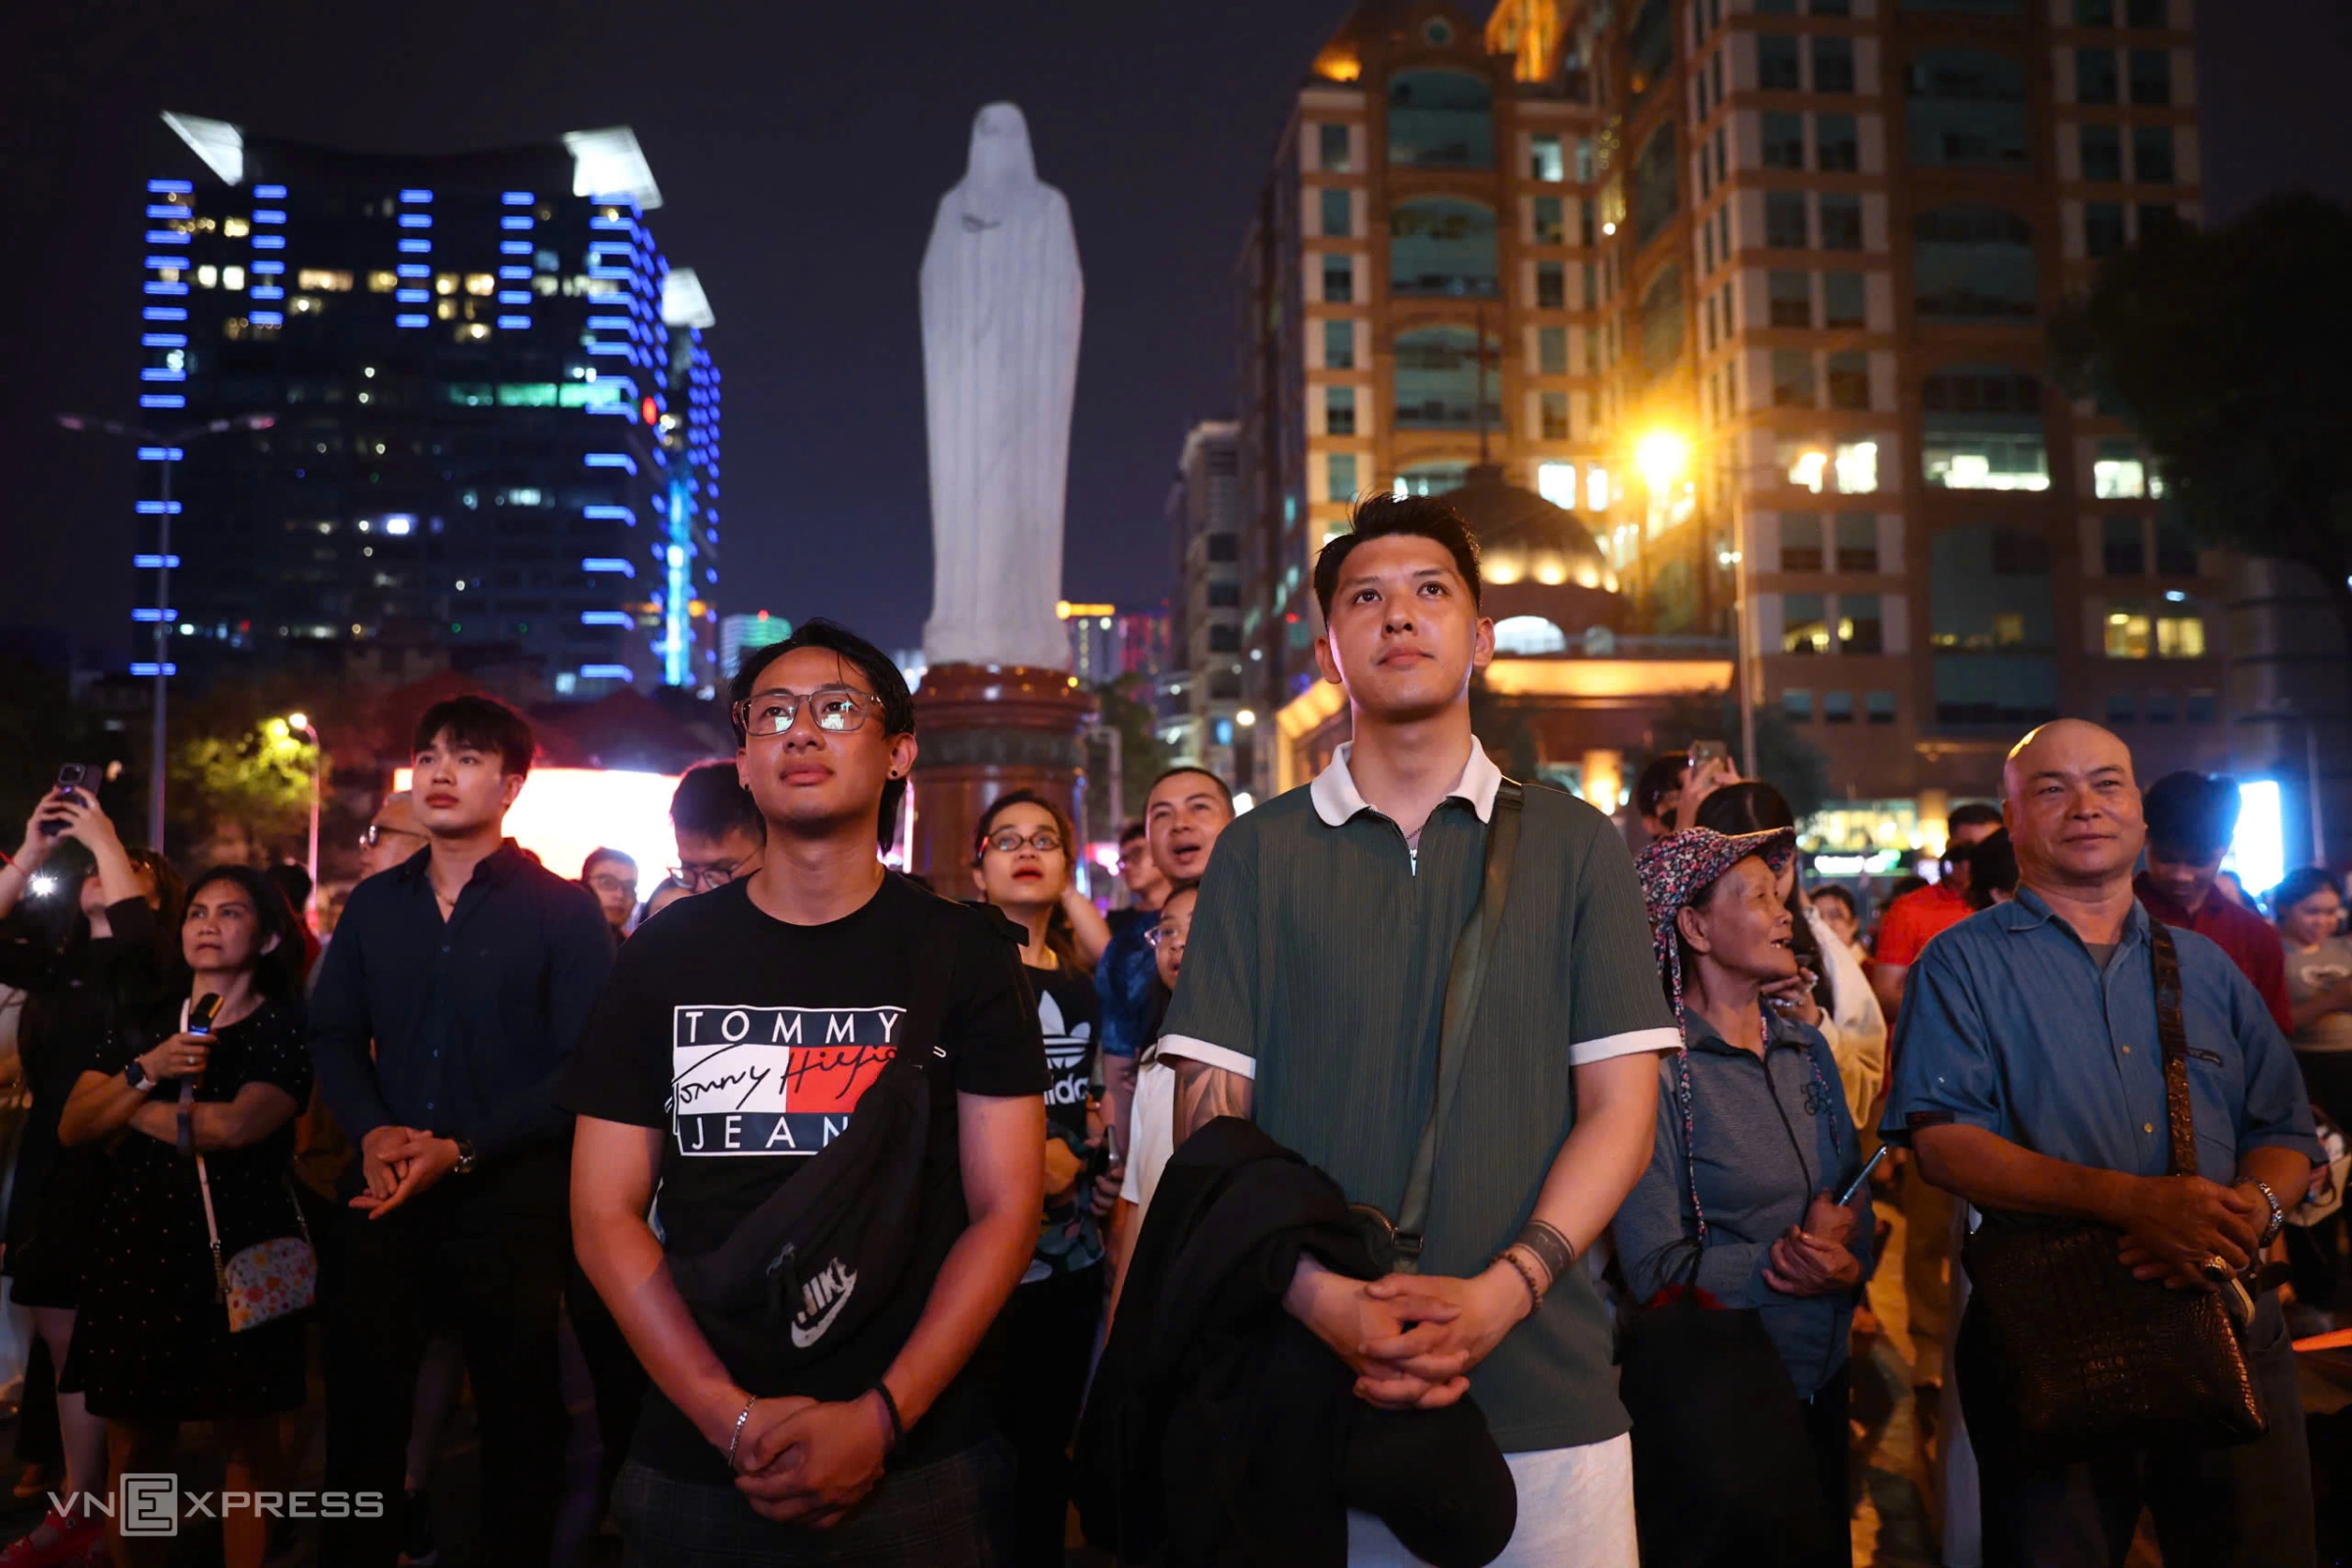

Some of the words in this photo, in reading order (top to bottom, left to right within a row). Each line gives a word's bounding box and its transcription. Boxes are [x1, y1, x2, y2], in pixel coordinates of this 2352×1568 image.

[685, 1010, 899, 1045] TOMMY
[666, 1043, 771, 1110] Tommy
[779, 1044, 898, 1100] Hilfi
[691, 1115, 849, 1150] JEAN
